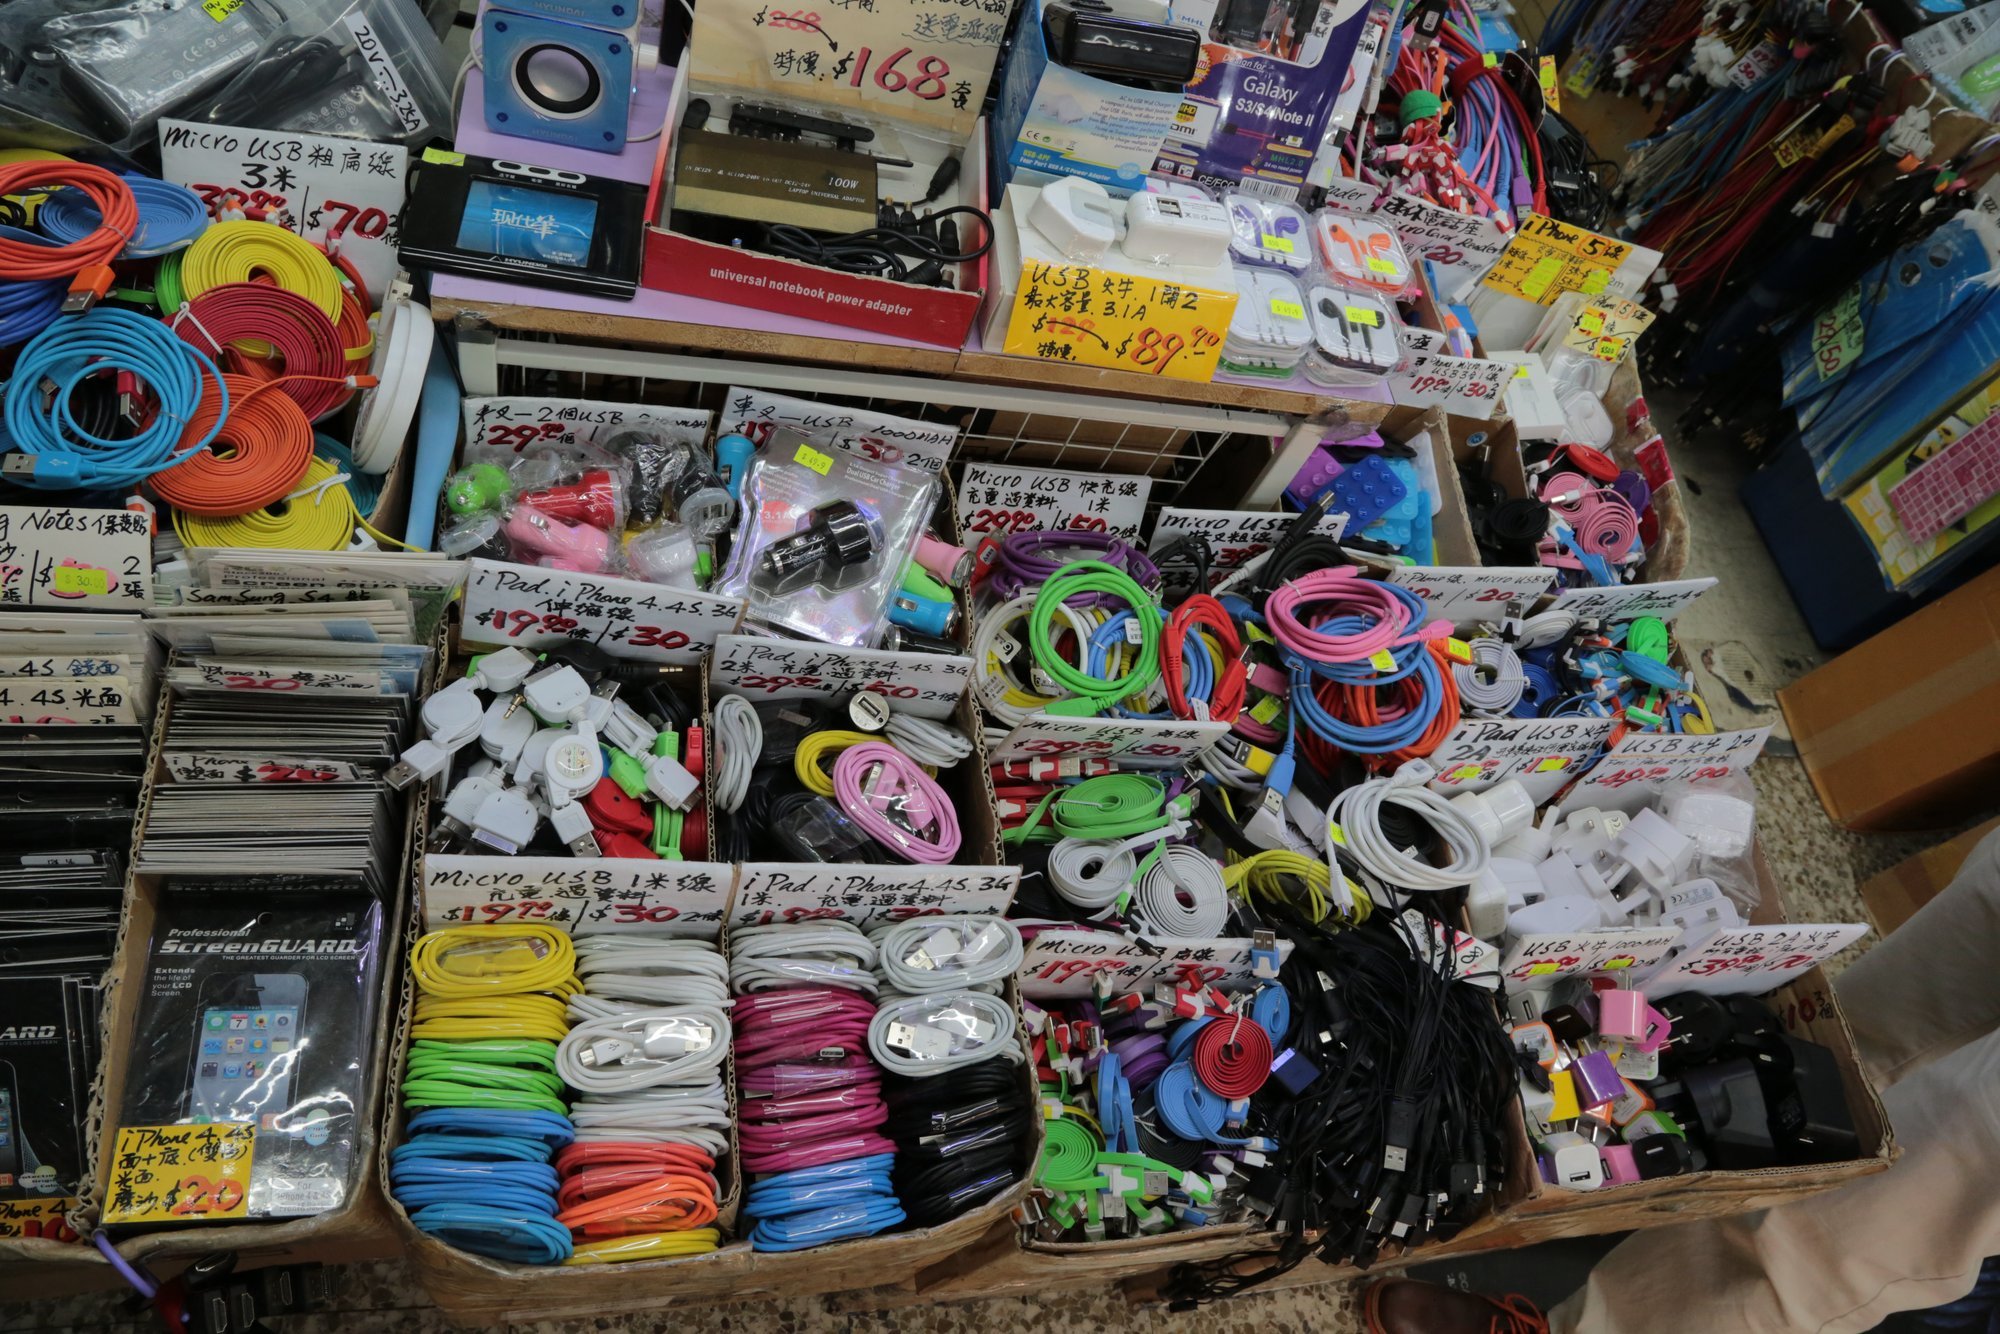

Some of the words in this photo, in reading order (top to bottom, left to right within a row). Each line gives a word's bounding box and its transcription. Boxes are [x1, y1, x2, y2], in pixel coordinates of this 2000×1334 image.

[833, 46, 951, 100] $168
[1243, 75, 1299, 106] Galaxy
[162, 126, 239, 153] Micro
[247, 137, 303, 162] USB
[828, 176, 859, 190] 100W
[306, 199, 389, 239] $70
[1031, 263, 1092, 290] USB
[709, 267, 768, 288] universal
[768, 278, 826, 301] notebook
[826, 291, 865, 311] power
[865, 299, 913, 317] adapter
[878, 476, 901, 491] Charger
[966, 467, 1022, 488] Micro
[1030, 475, 1071, 493] USB
[20, 508, 88, 532] Notes
[1161, 515, 1231, 530] Micro
[557, 580, 632, 606] iPhone
[609, 625, 690, 649] $30
[805, 651, 881, 671] iPhone
[1022, 720, 1087, 733] Micro
[1096, 725, 1145, 736] USB
[1453, 722, 1528, 743] iPad
[1527, 723, 1579, 741] USB
[1621, 738, 1684, 755] USB
[429, 869, 524, 887] Micro
[541, 869, 613, 886] USB
[825, 874, 909, 894] iPhone
[588, 903, 681, 923] $30
[167, 928, 251, 938] Professional
[1713, 932, 1765, 948] USB
[159, 938, 357, 954] ScreenGUARD
[1035, 938, 1107, 956] Micro
[1522, 939, 1572, 957] USB
[120, 1128, 192, 1153] iPhone
